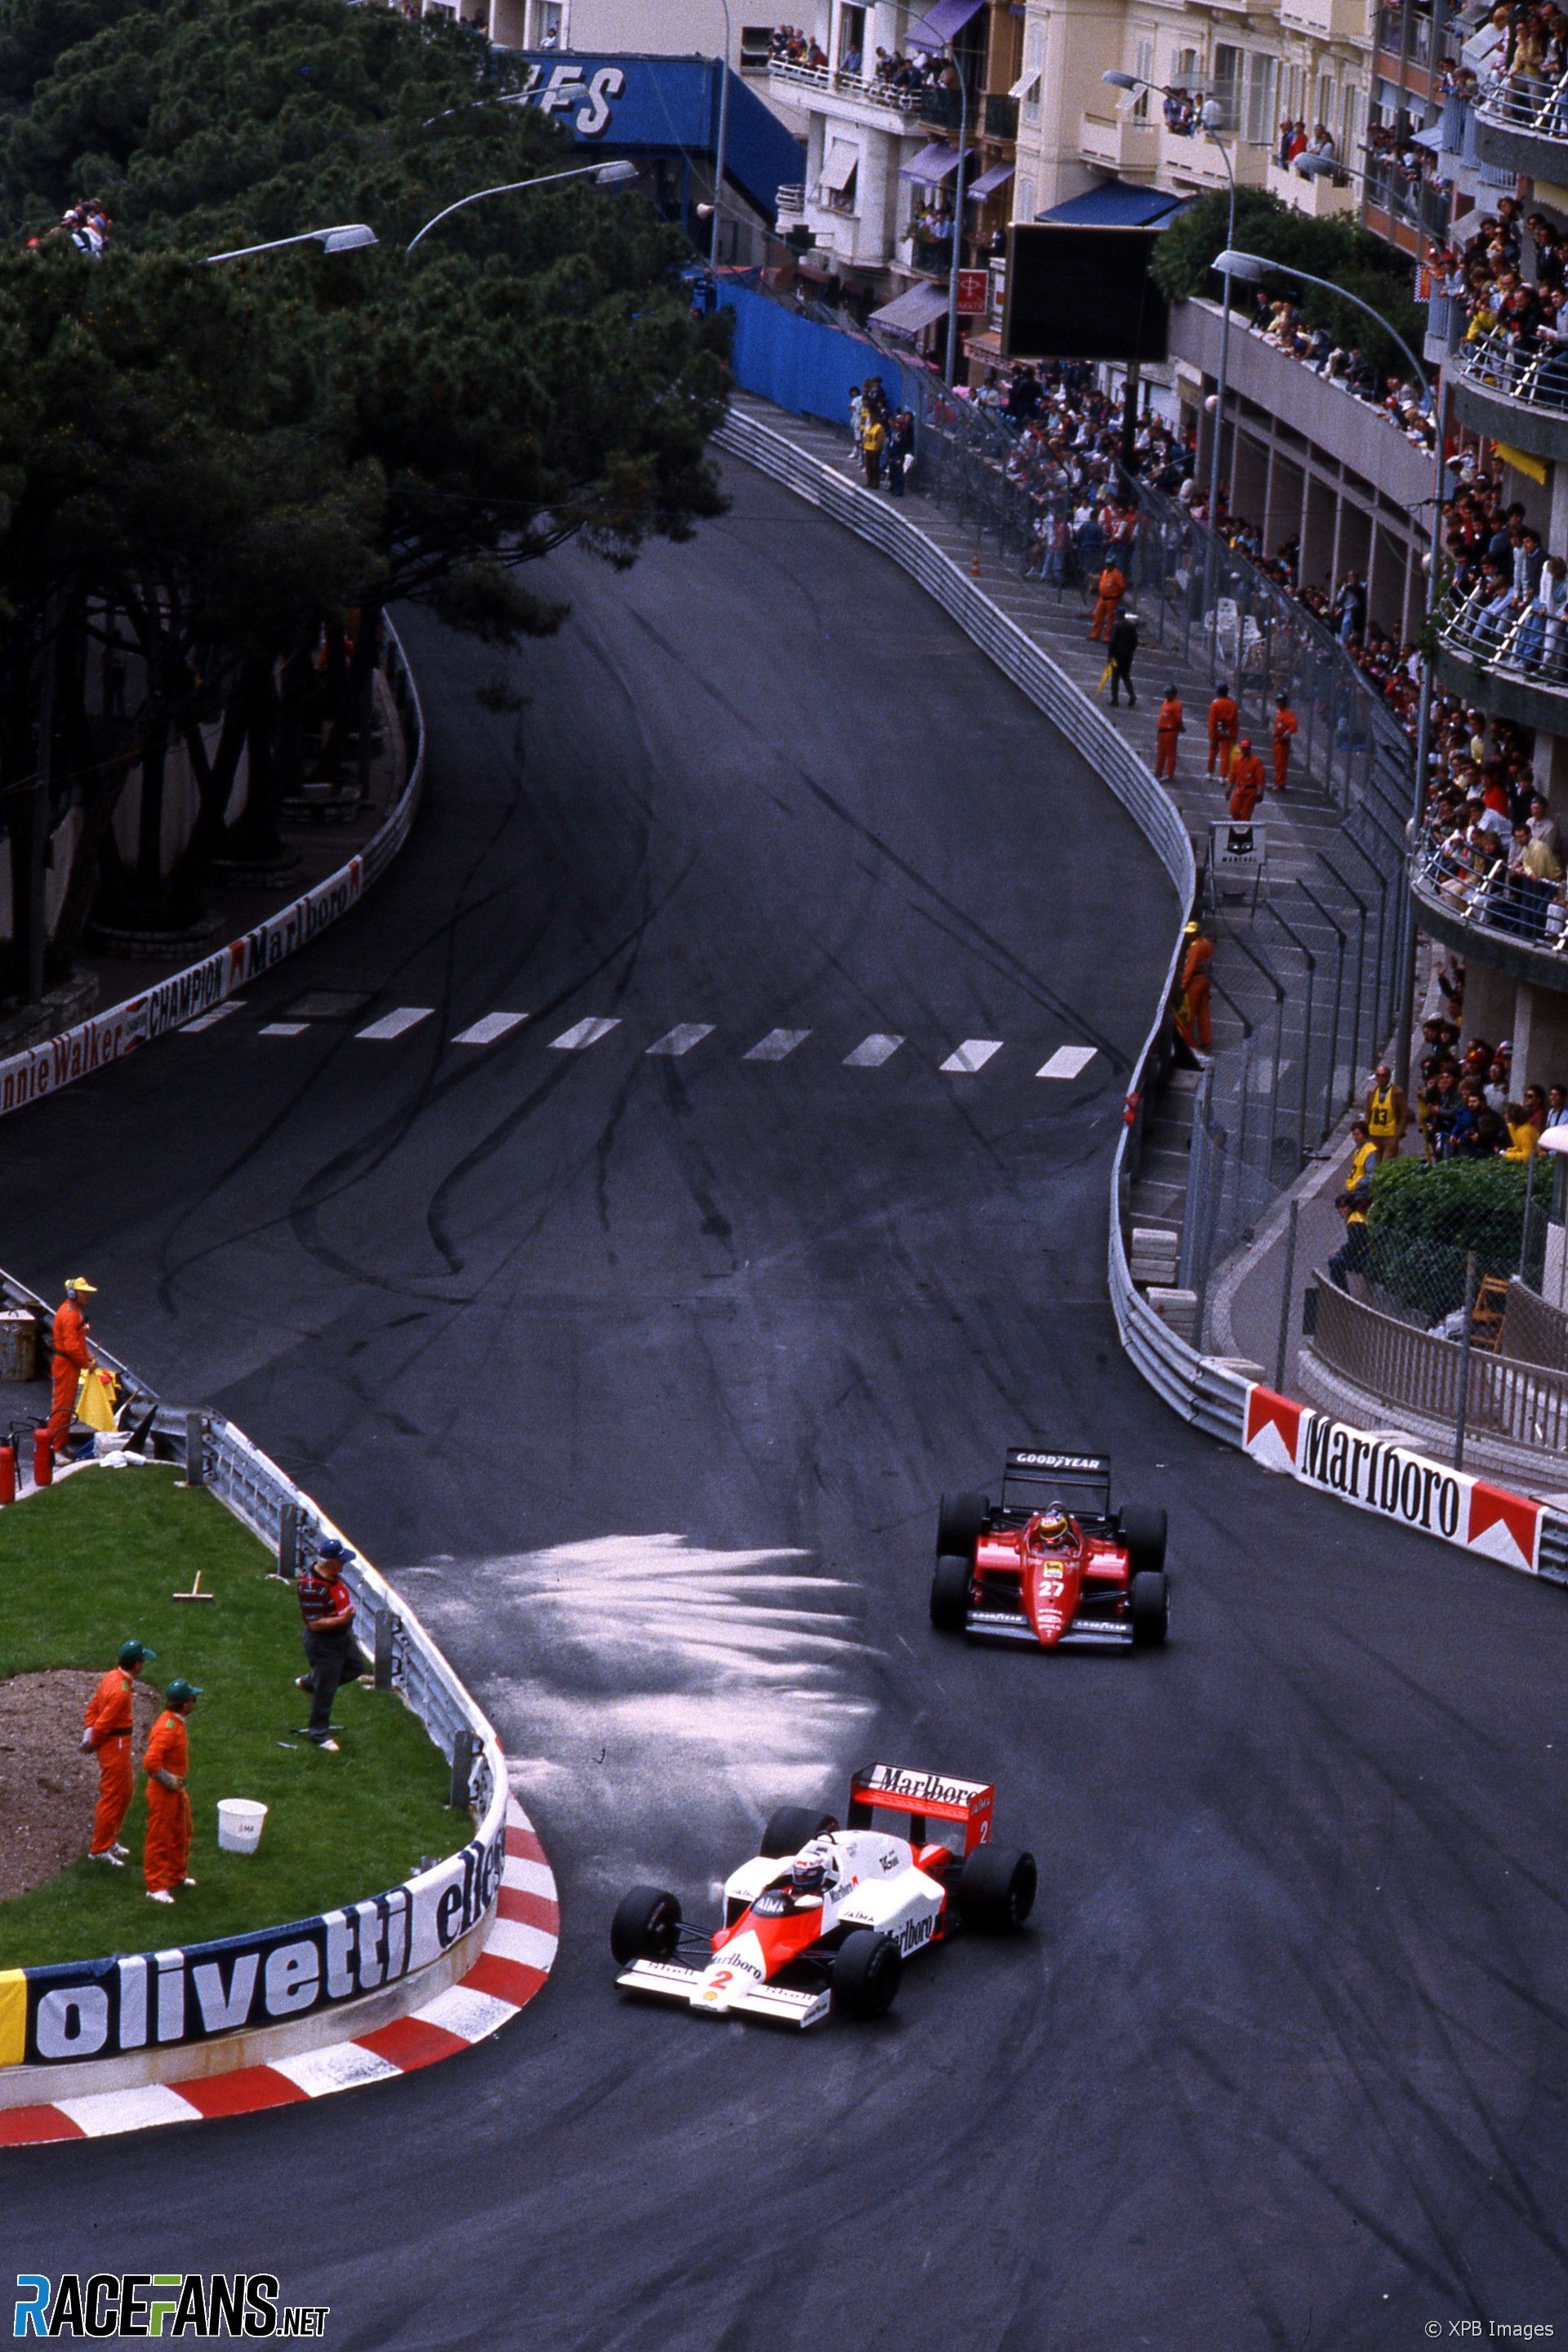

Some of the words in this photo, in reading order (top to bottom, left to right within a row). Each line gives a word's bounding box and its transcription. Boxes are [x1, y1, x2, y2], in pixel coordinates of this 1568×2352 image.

[247, 884, 349, 979] Marlboro
[149, 955, 223, 1036] CHAMPION
[51, 1022, 122, 1085] Walker
[1016, 1453, 1100, 1468] GOODYEAR
[1302, 1413, 1460, 1538] Marlboro
[1038, 1580, 1065, 1598] 27
[972, 1612, 1022, 1621] GOODYEAR
[1076, 1622, 1127, 1631] GOODYEAR
[980, 1820, 989, 1844] 2
[36, 1889, 408, 2059] olivetti
[713, 1953, 762, 1980] arlboro
[708, 1971, 733, 1990] 2
